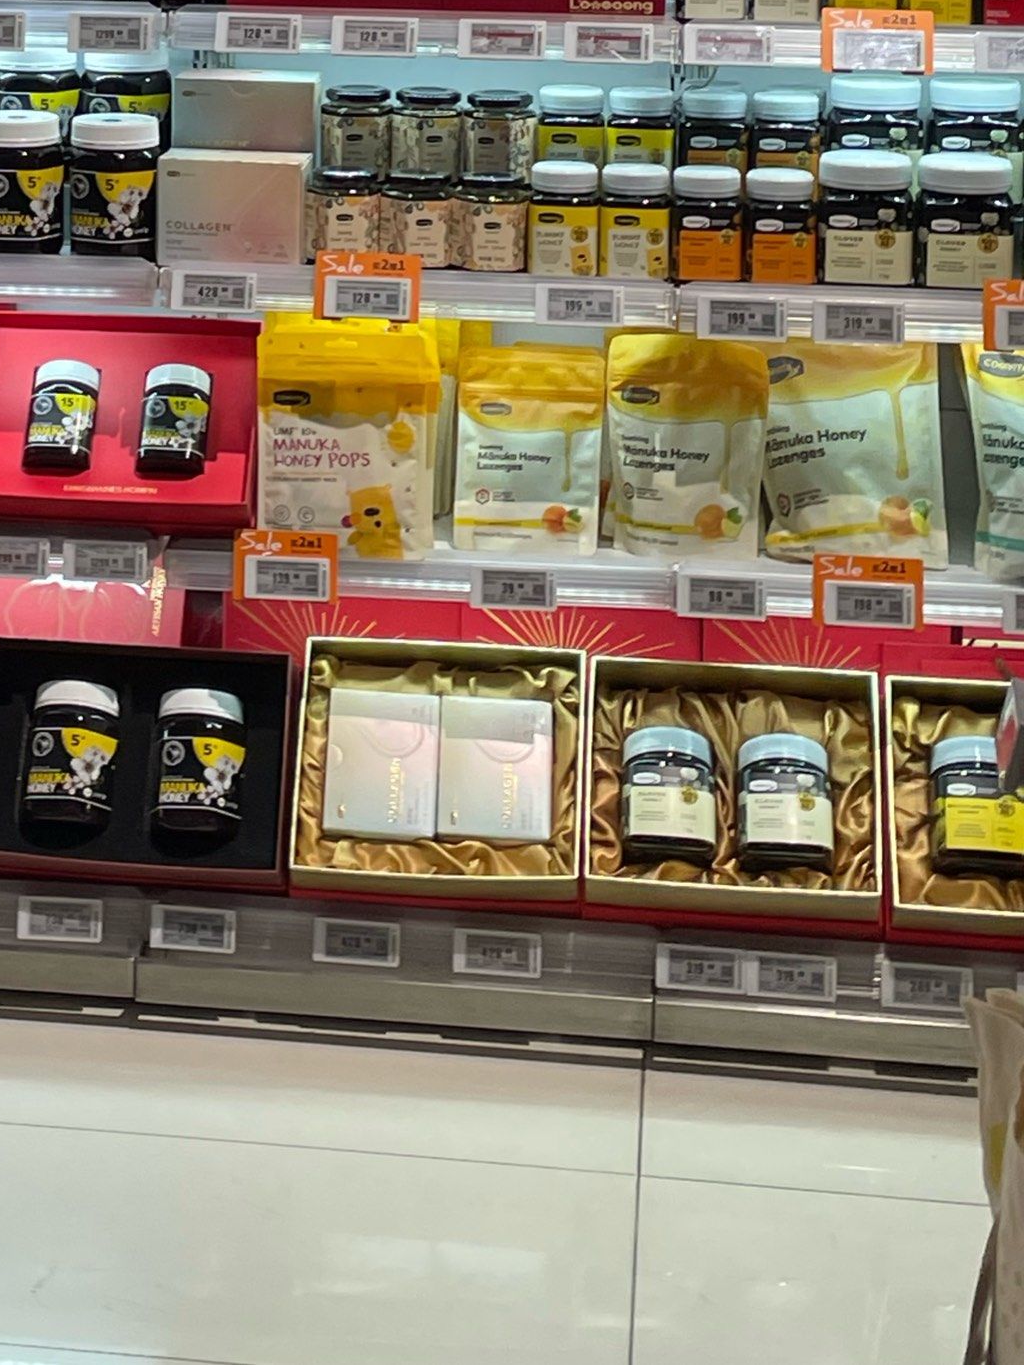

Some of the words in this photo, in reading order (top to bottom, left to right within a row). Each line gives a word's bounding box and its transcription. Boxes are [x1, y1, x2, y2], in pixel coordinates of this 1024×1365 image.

[828, 11, 874, 29] Sale
[166, 220, 232, 231] COLLAGEN
[321, 255, 365, 274] Sale
[990, 284, 1024, 302] Sal
[817, 428, 867, 443] Honey
[273, 439, 340, 451] MANUKA
[274, 454, 323, 467] HONEY
[328, 452, 370, 468] POPS
[518, 452, 552, 464] Honey
[670, 449, 710, 464] Honey
[477, 462, 523, 473] Lozenges
[623, 457, 675, 473] Lozenges
[241, 532, 282, 551] Sale
[819, 557, 862, 576] Sale
